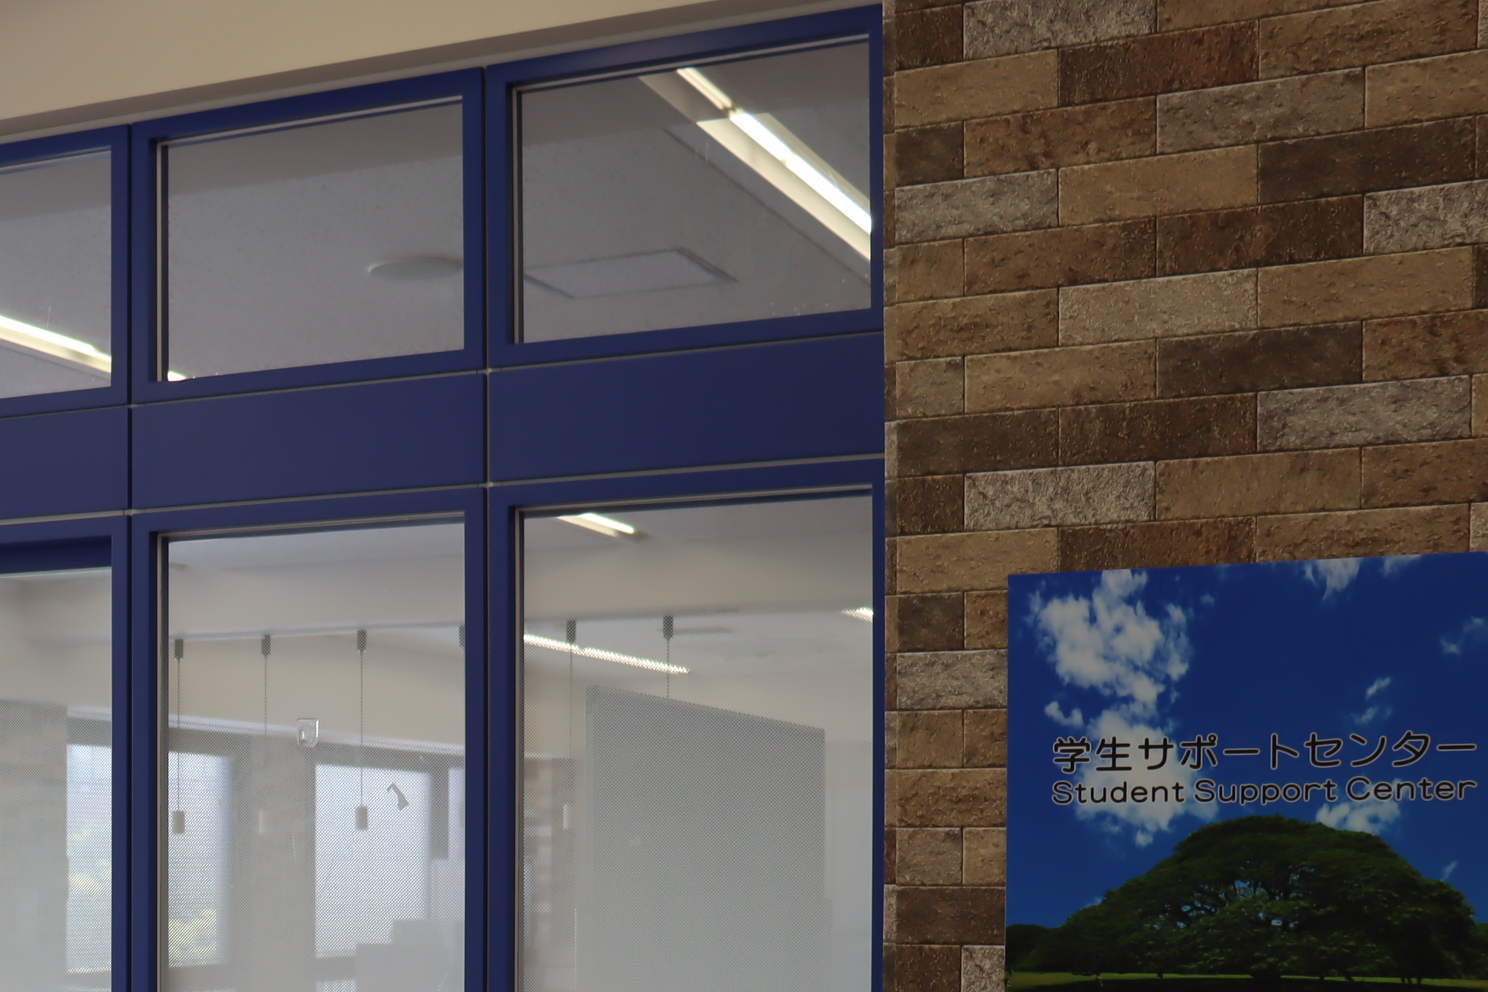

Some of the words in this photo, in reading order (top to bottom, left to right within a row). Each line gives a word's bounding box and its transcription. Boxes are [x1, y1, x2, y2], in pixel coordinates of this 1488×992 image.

[1052, 730, 1478, 773] 学生サポートセンター
[1052, 780, 1185, 805] Student
[1194, 778, 1338, 806] Support
[1345, 776, 1478, 801] Center
